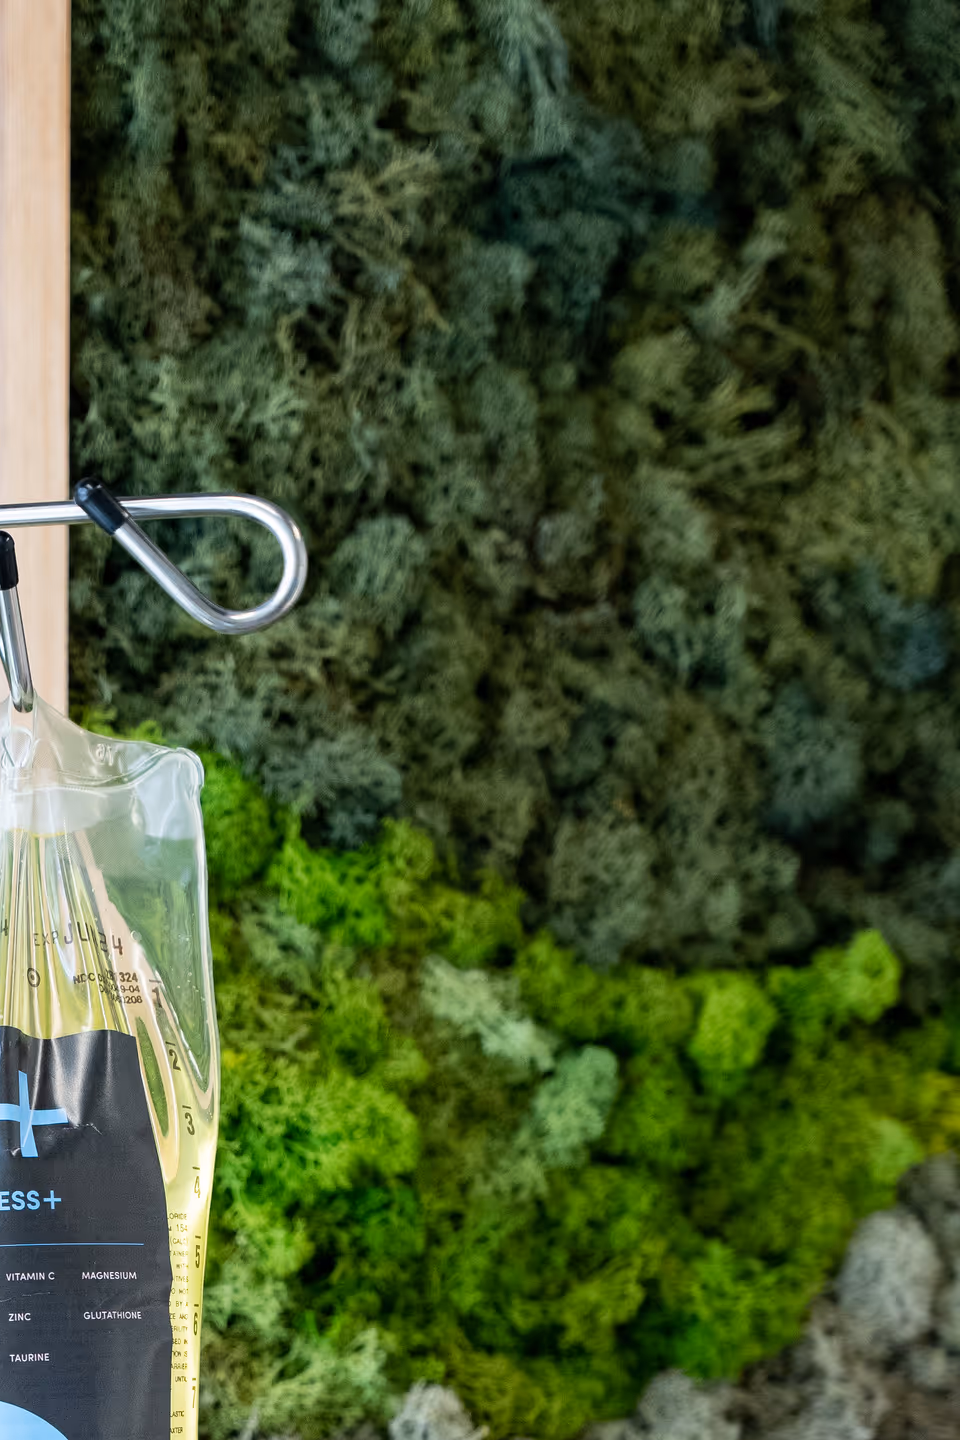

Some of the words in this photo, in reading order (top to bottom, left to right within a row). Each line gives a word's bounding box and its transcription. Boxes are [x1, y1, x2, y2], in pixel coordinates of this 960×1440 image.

[33, 930, 59, 947] EXP
[72, 972, 96, 985] NDC
[168, 1048, 182, 1071] 2
[184, 1111, 195, 1135] 3
[194, 1175, 201, 1199] 4
[195, 1245, 201, 1269] 5
[5, 1272, 45, 1281] VITAMIN
[48, 1271, 55, 1281] C
[81, 1271, 137, 1280] MAGNESIUM
[8, 1312, 32, 1322] ZINC
[83, 1311, 142, 1320] GLUTATHIONE
[193, 1312, 198, 1336] 6
[9, 1352, 50, 1363] TAURINE
